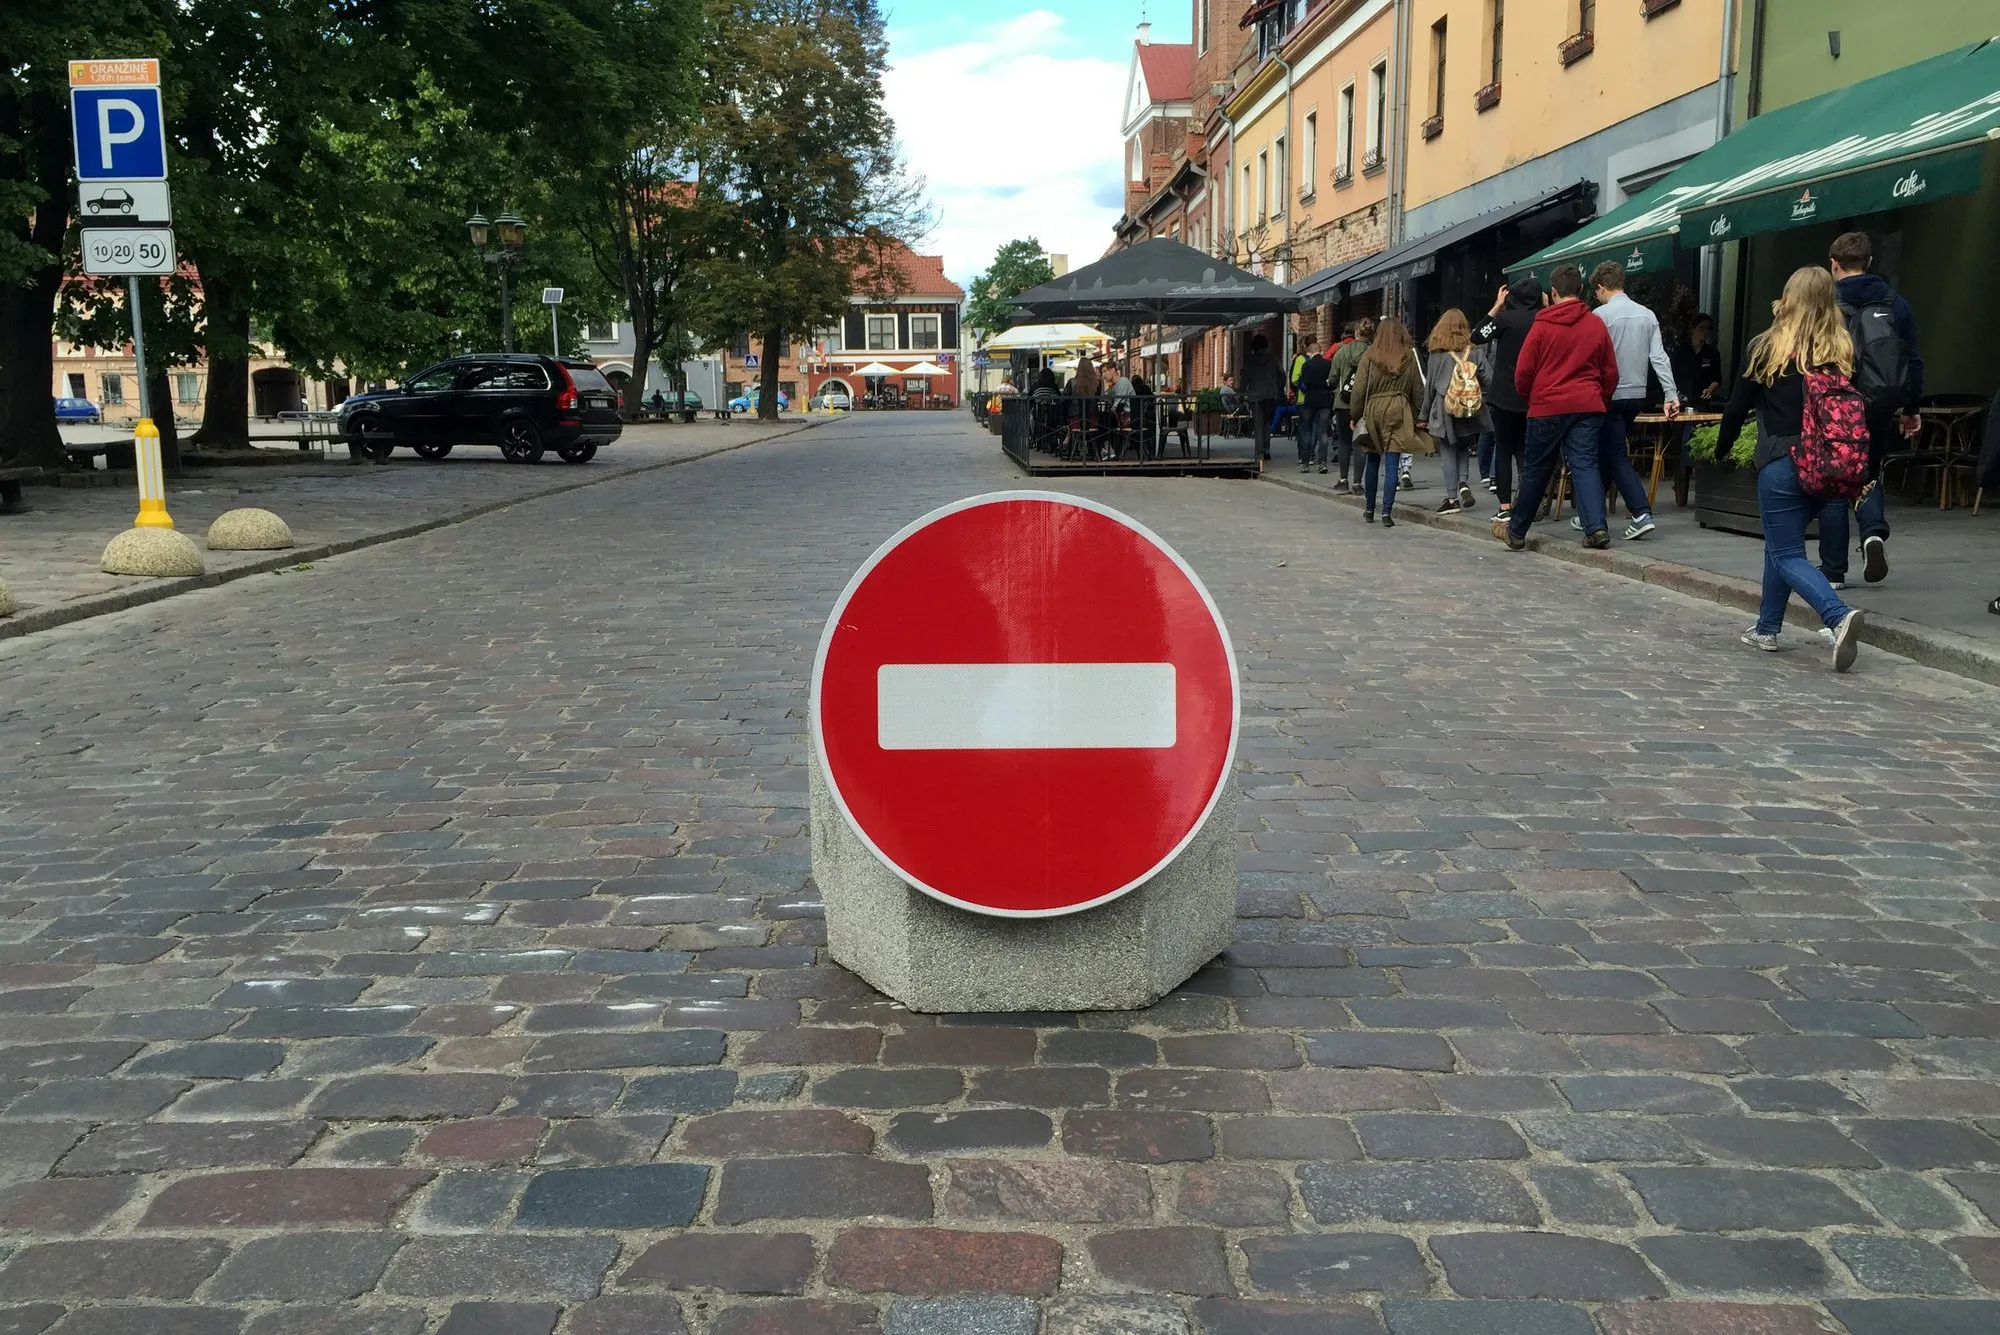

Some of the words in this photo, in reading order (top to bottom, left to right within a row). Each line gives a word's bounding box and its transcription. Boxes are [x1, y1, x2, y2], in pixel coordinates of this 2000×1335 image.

[90, 62, 148, 74] ORANŽINĖ
[97, 99, 145, 169] P
[1893, 169, 1918, 197] Cafe
[95, 246, 108, 256] 10
[114, 245, 130, 257] 20
[140, 244, 160, 259] 50
